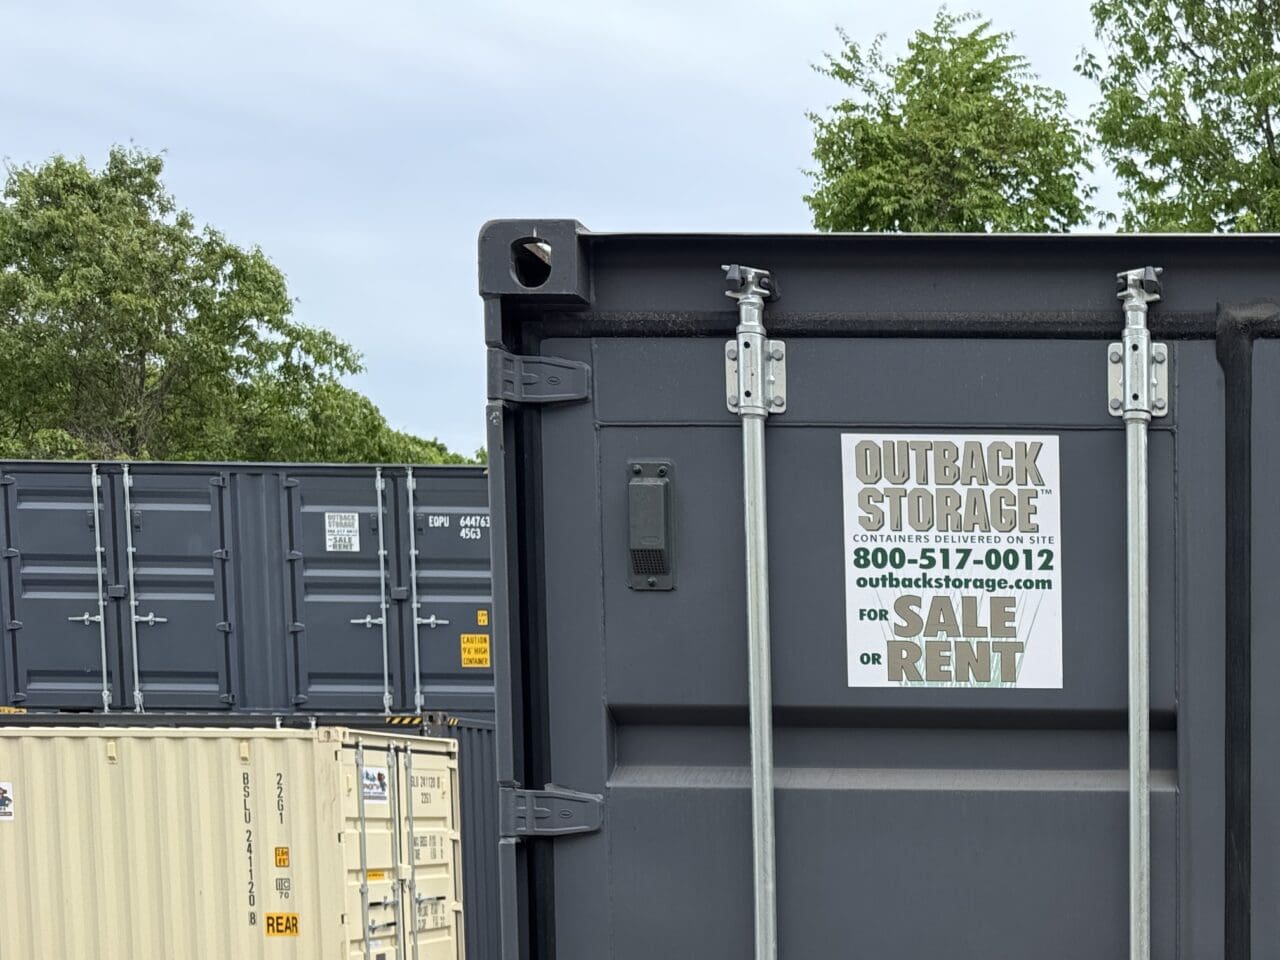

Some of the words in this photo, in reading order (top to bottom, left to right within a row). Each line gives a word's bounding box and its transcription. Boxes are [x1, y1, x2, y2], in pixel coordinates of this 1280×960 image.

[855, 440, 1045, 486] OUTBACK
[429, 516, 449, 527] EQPU
[460, 529, 481, 539] 45G3
[853, 534, 930, 543] CONTAINERS
[935, 536, 1001, 544] DELIVERED
[1007, 536, 1023, 544] ON
[1029, 536, 1054, 544] SITE
[854, 547, 1054, 571] 800-517-0012
[856, 573, 1052, 592] outbackstorage.com
[859, 609, 888, 621] FOR
[893, 595, 1016, 638] SALE
[860, 653, 881, 665] OR
[887, 640, 1024, 682] RENT
[243, 773, 251, 823] BSLU
[276, 773, 284, 824] 22G1
[246, 830, 255, 906] 241120
[267, 916, 298, 933] REAR
